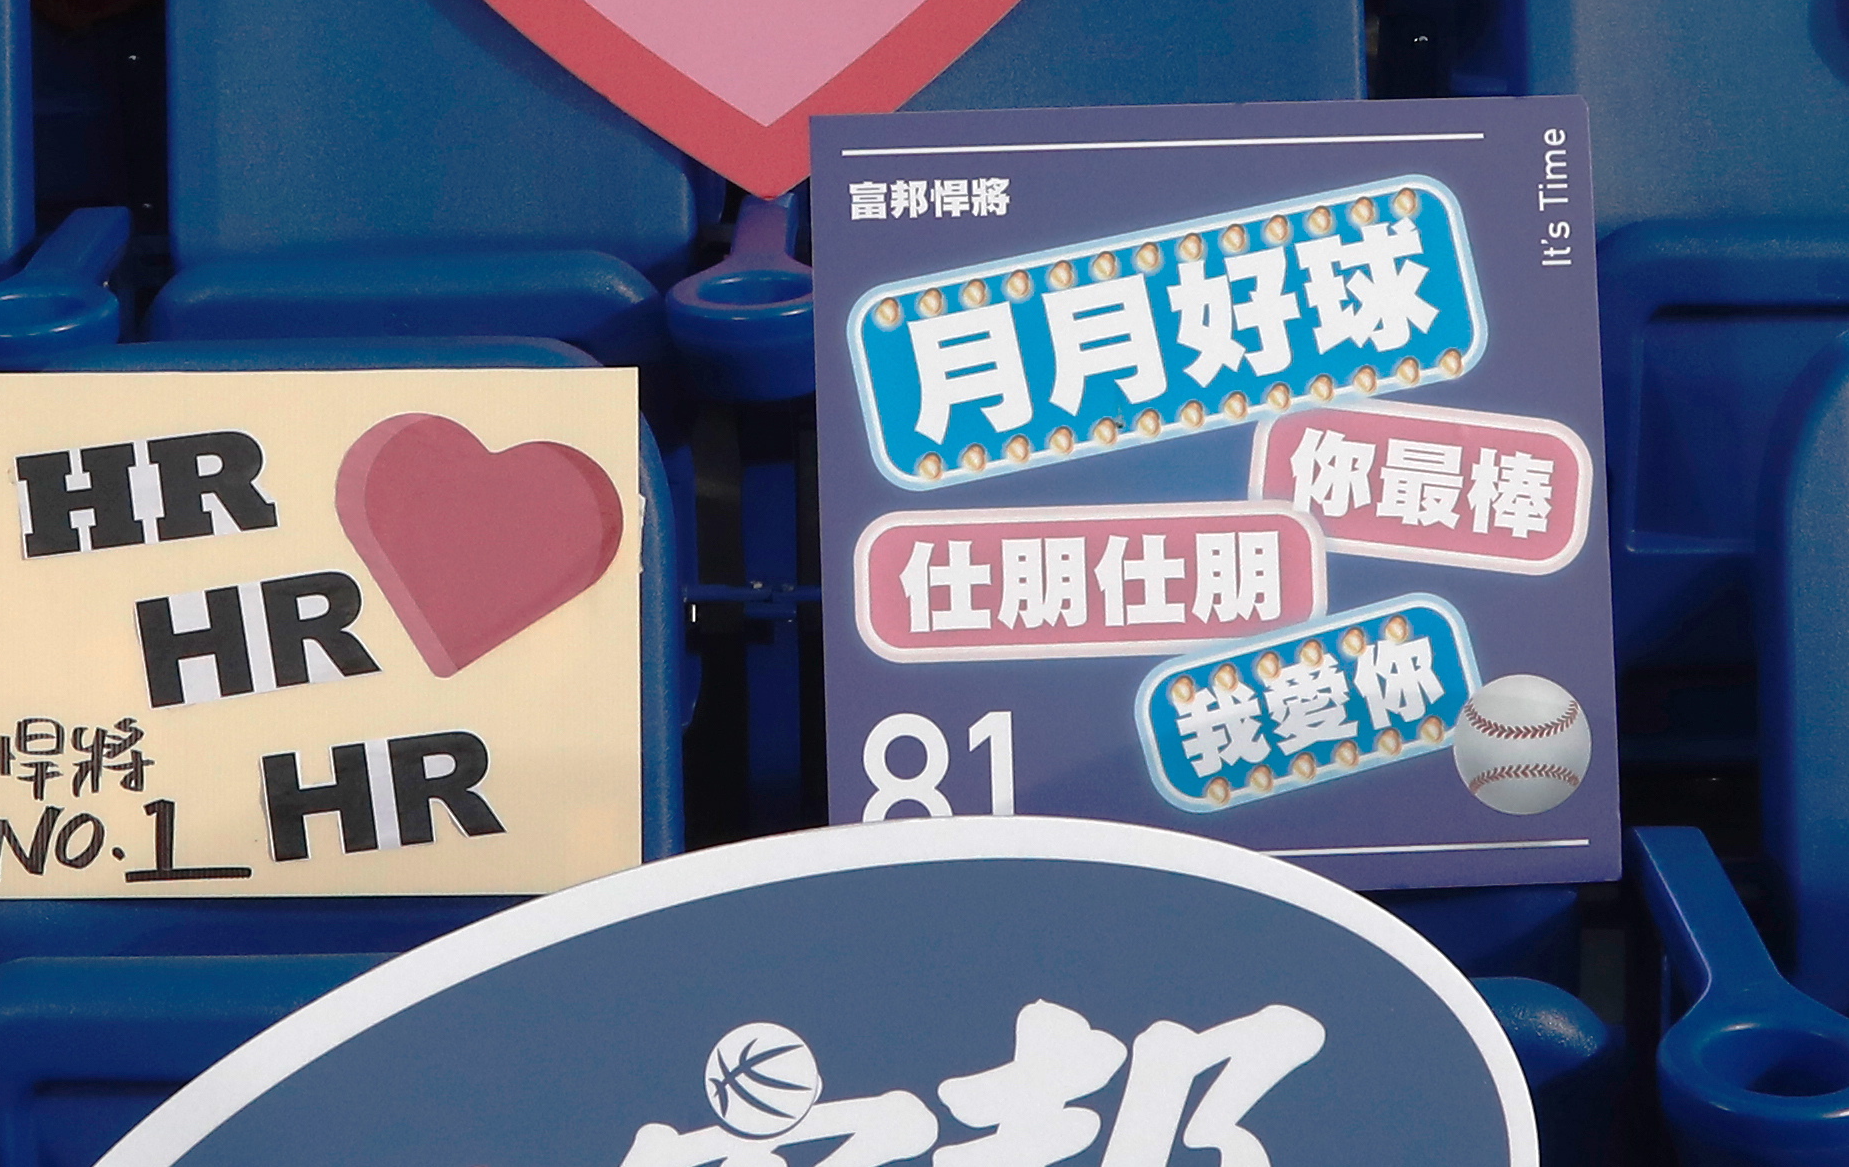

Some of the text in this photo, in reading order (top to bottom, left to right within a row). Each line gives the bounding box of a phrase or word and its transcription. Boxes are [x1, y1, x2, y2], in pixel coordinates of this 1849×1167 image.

[848, 177, 1011, 220] 富邦悍將
[1539, 127, 1571, 209] Time
[906, 219, 1440, 444] 月月好球
[16, 430, 278, 559] HR
[1290, 427, 1555, 540] 你最棒
[135, 571, 382, 709] HR
[900, 531, 1282, 633] 仕朋仕朋
[862, 710, 1016, 823] 81
[1175, 637, 1445, 778] 我愛你
[261, 731, 507, 862] HR
